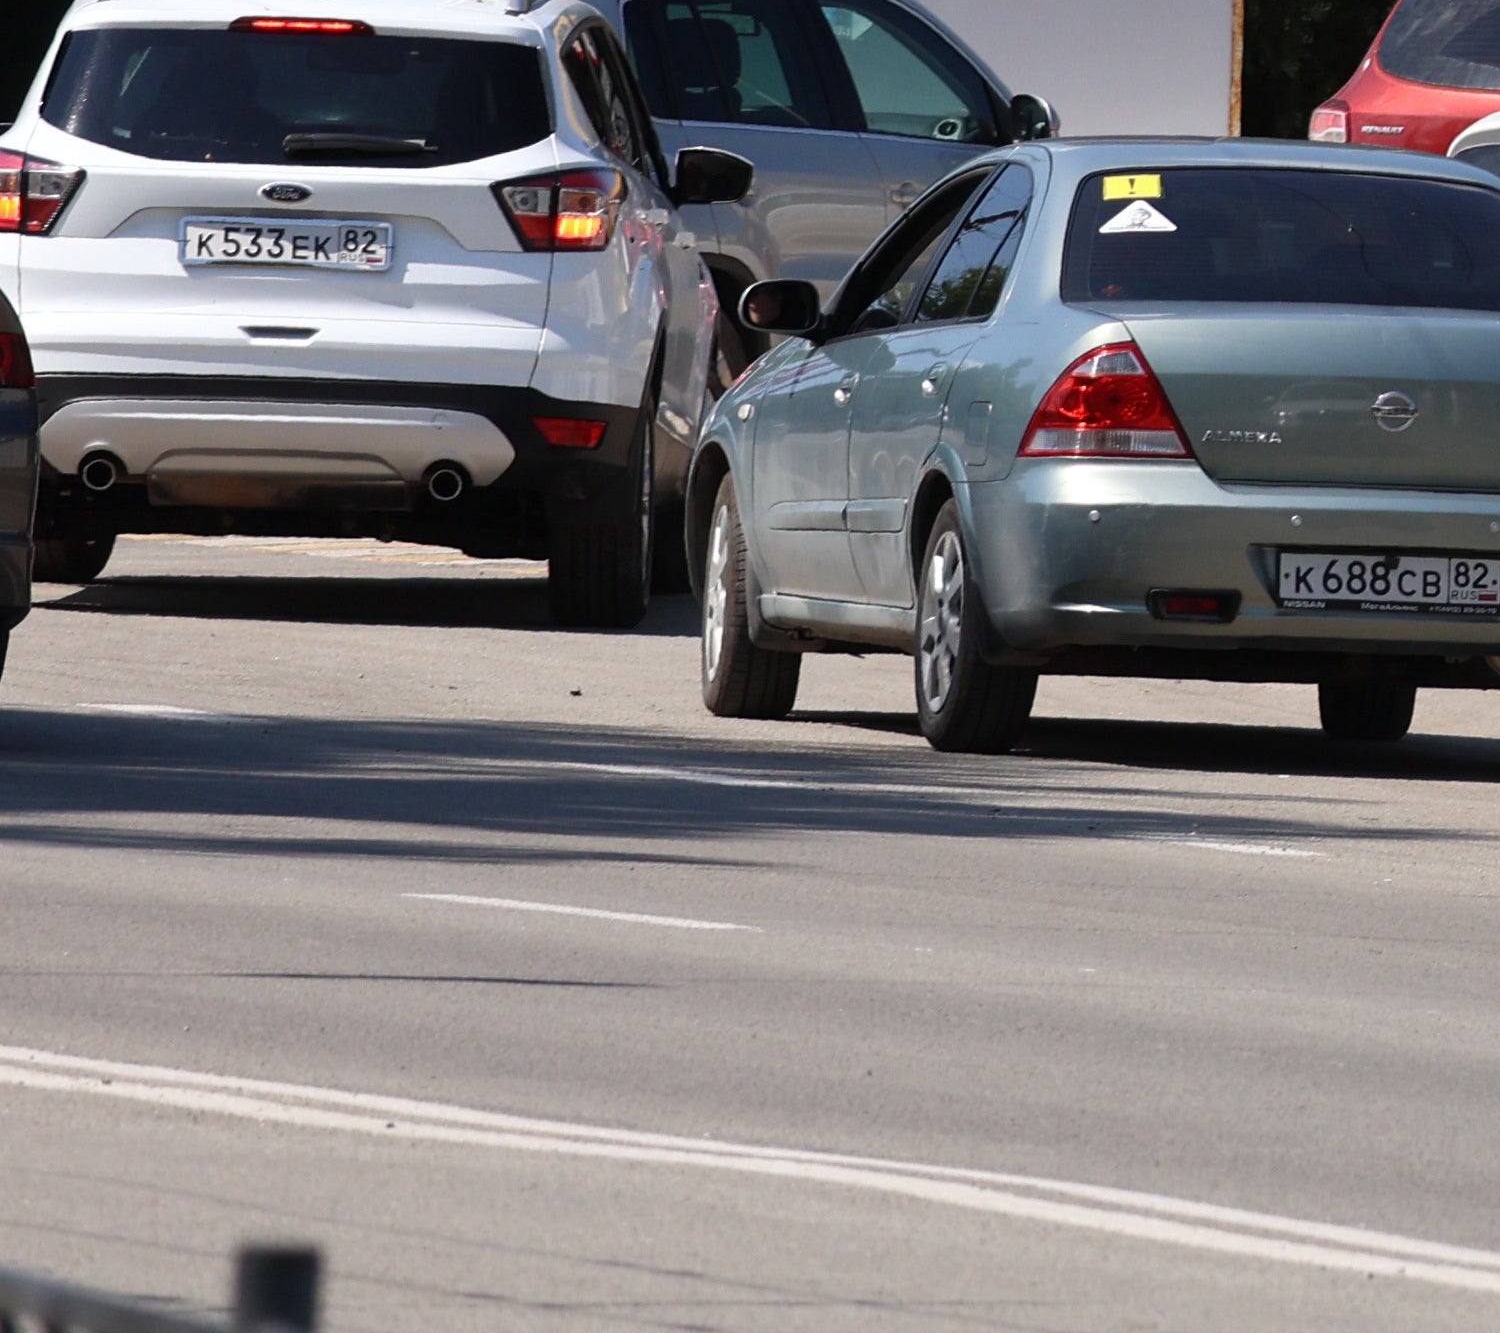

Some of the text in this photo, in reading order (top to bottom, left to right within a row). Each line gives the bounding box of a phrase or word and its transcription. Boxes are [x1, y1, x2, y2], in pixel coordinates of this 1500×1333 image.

[196, 226, 378, 262] К533ЕК 82
[340, 251, 366, 264] RUS
[1295, 559, 1489, 598] К688СВ 82
[1451, 589, 1478, 601] RUS
[1283, 600, 1327, 610] NISSAN
